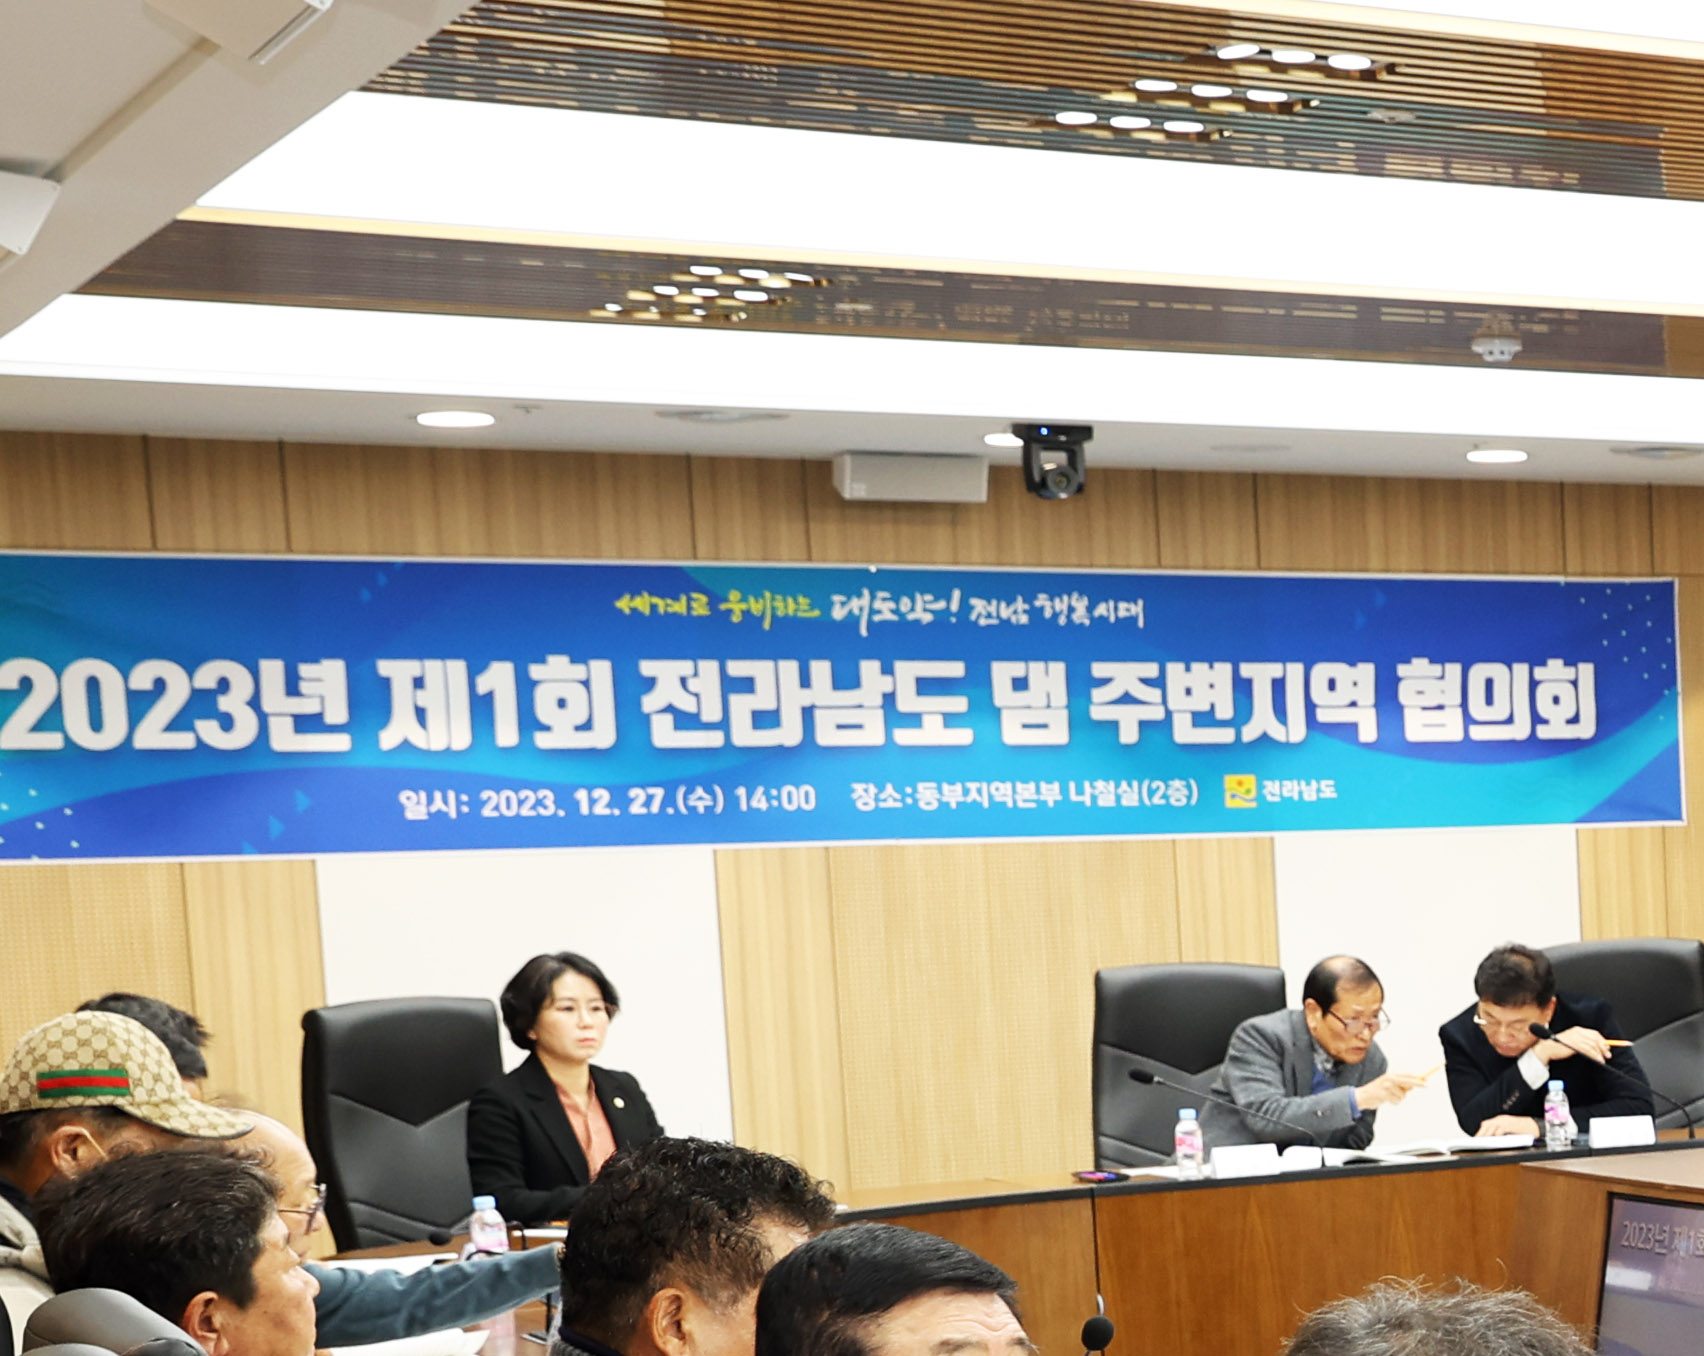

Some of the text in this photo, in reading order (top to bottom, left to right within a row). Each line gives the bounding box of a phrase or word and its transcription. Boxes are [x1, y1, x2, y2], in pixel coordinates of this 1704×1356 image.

[831, 587, 960, 637] 대도약!
[969, 595, 1030, 628] 전남
[0, 654, 1597, 753] 2023년 제1회 전라남도 댐 주변지역 협의회
[399, 788, 470, 820] 일시:
[480, 788, 565, 818] 2023.
[573, 788, 621, 818] 12.
[734, 786, 816, 814] 14:00
[1261, 779, 1338, 806] 전라남도
[1621, 1220, 1669, 1256] 2023년
